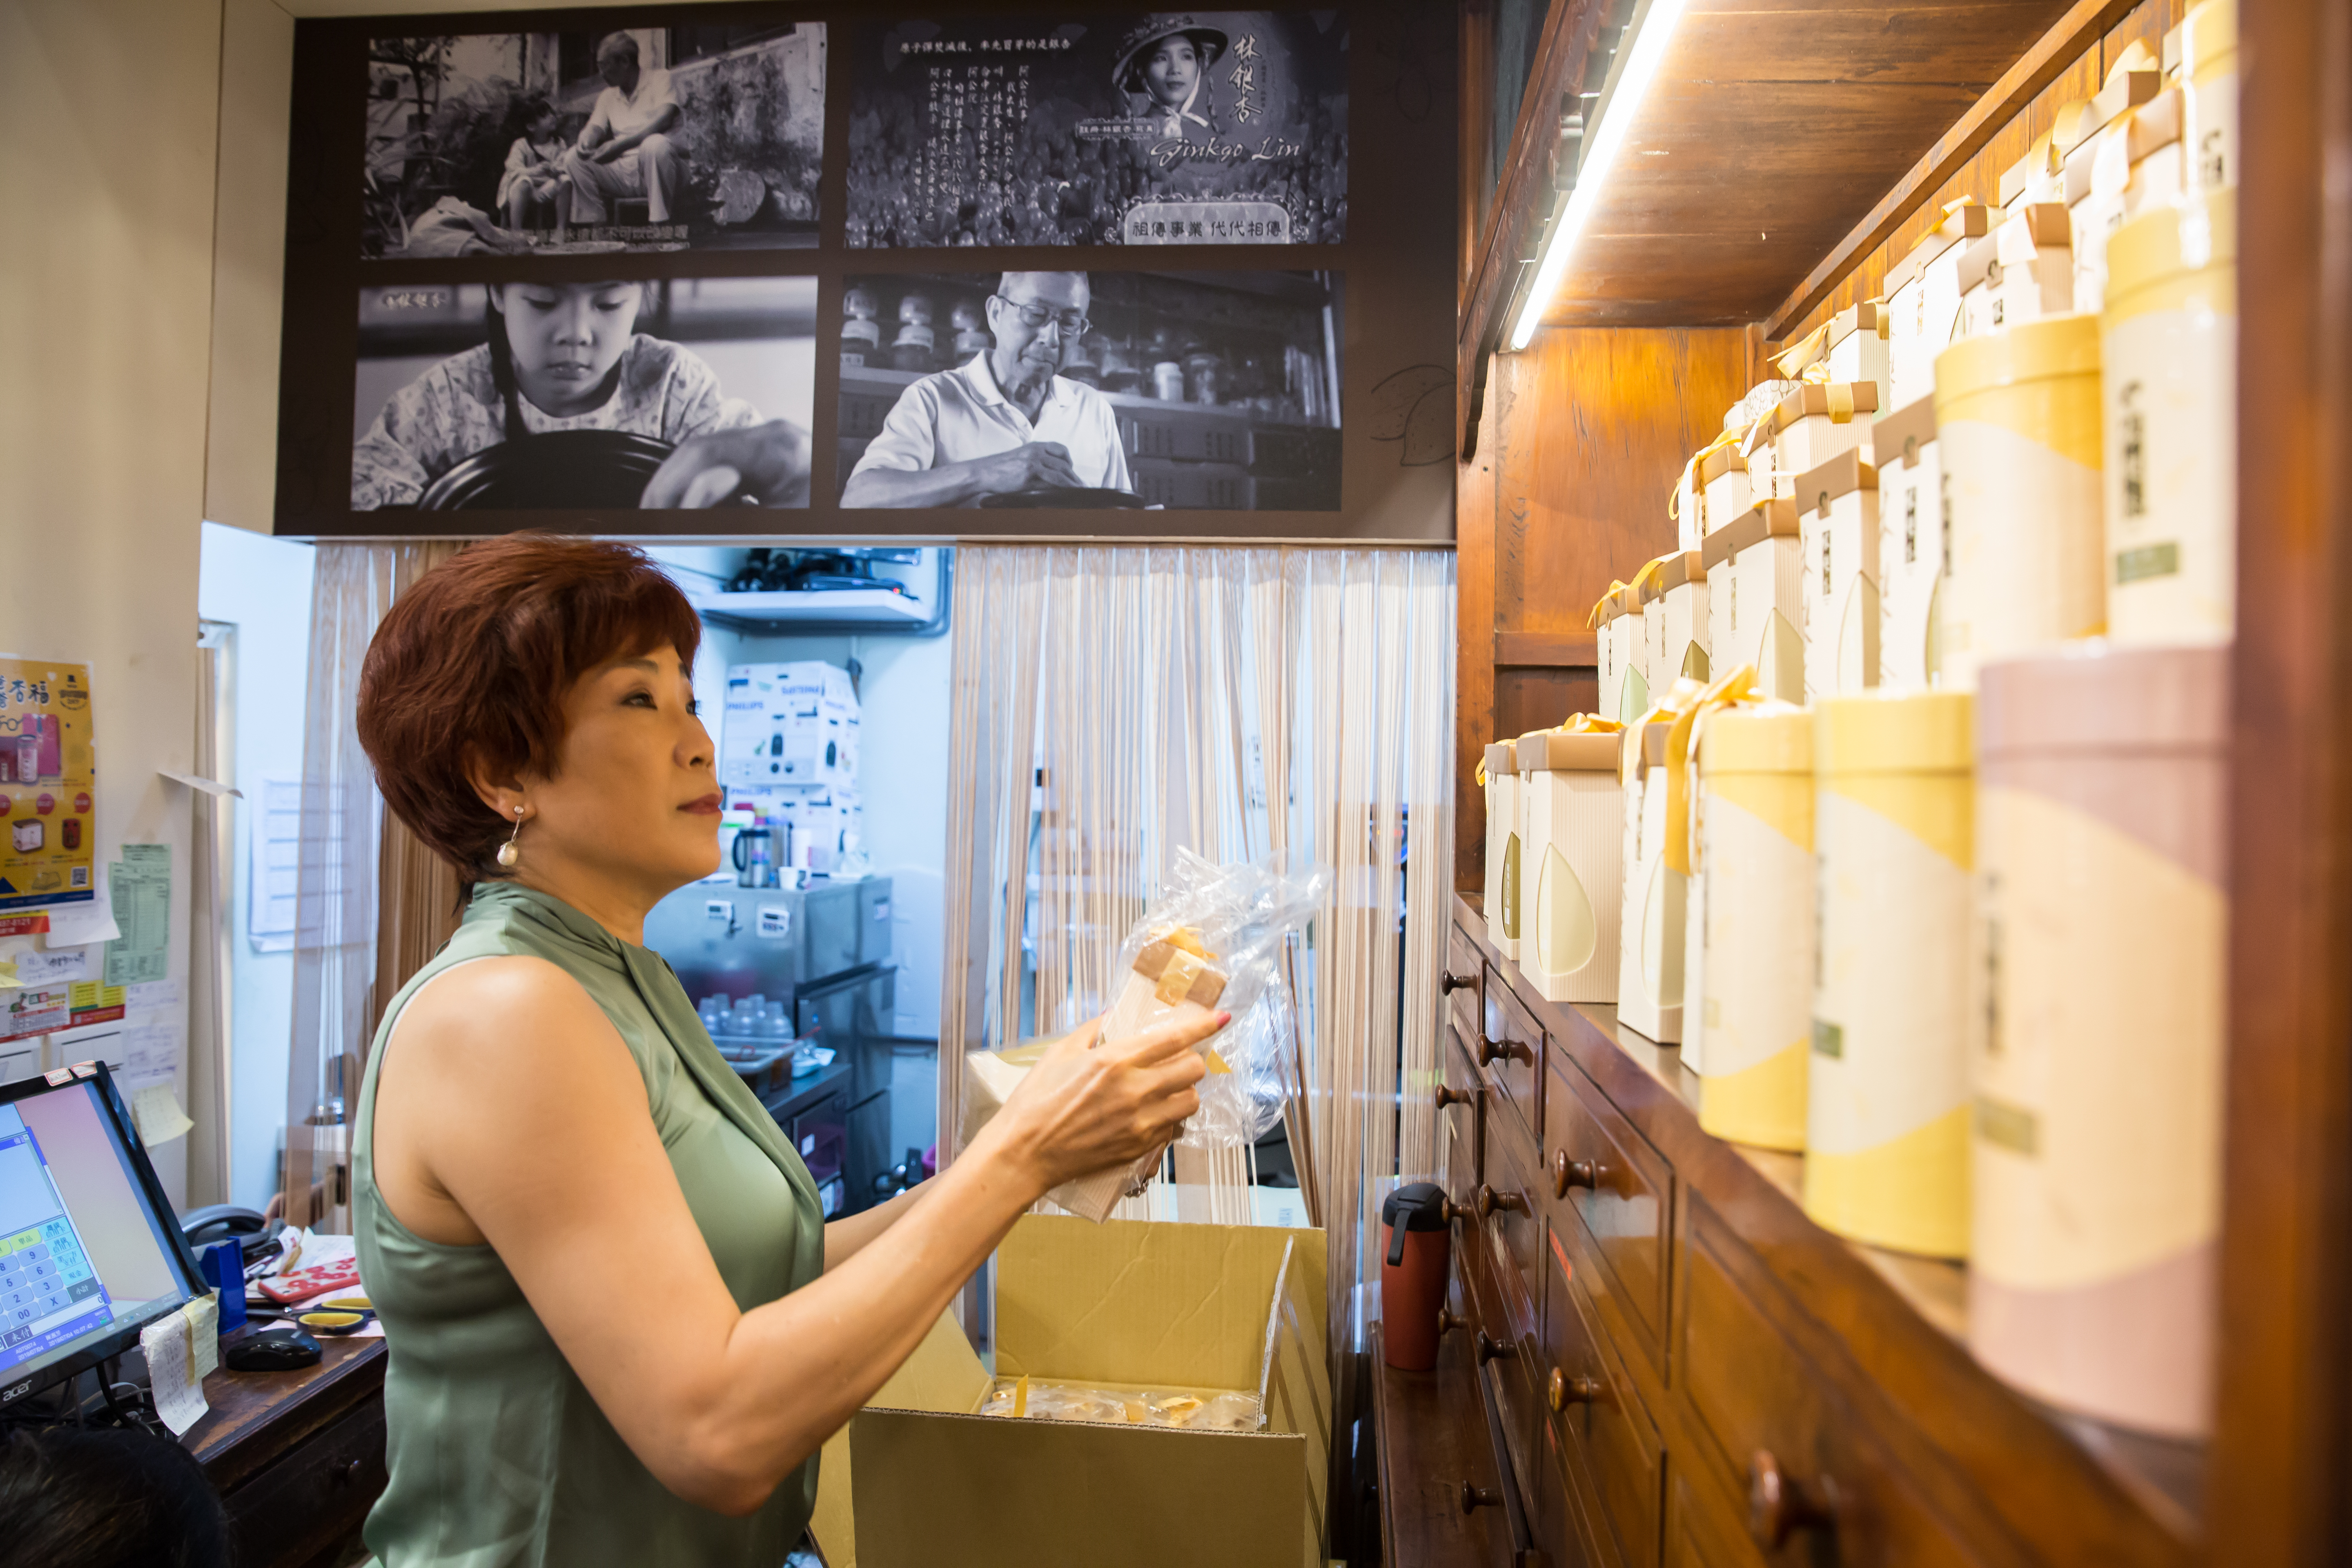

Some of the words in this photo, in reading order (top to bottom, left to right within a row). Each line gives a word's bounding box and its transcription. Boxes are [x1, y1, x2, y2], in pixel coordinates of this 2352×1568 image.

[1229, 34, 1263, 123] 林銀杏
[1150, 137, 1243, 167] Ginkgo
[1251, 136, 1301, 161] Lin
[1132, 220, 1203, 237] 祖傳事業
[1211, 220, 1282, 237] 代代相傳
[29, 1251, 36, 1260] 9
[36, 1266, 43, 1275] 6
[6, 1278, 13, 1287] 5
[43, 1282, 50, 1290] 3
[13, 1294, 21, 1303] 2
[49, 1296, 59, 1306] X
[18, 1309, 31, 1320] 00
[3, 1379, 32, 1401] acer
